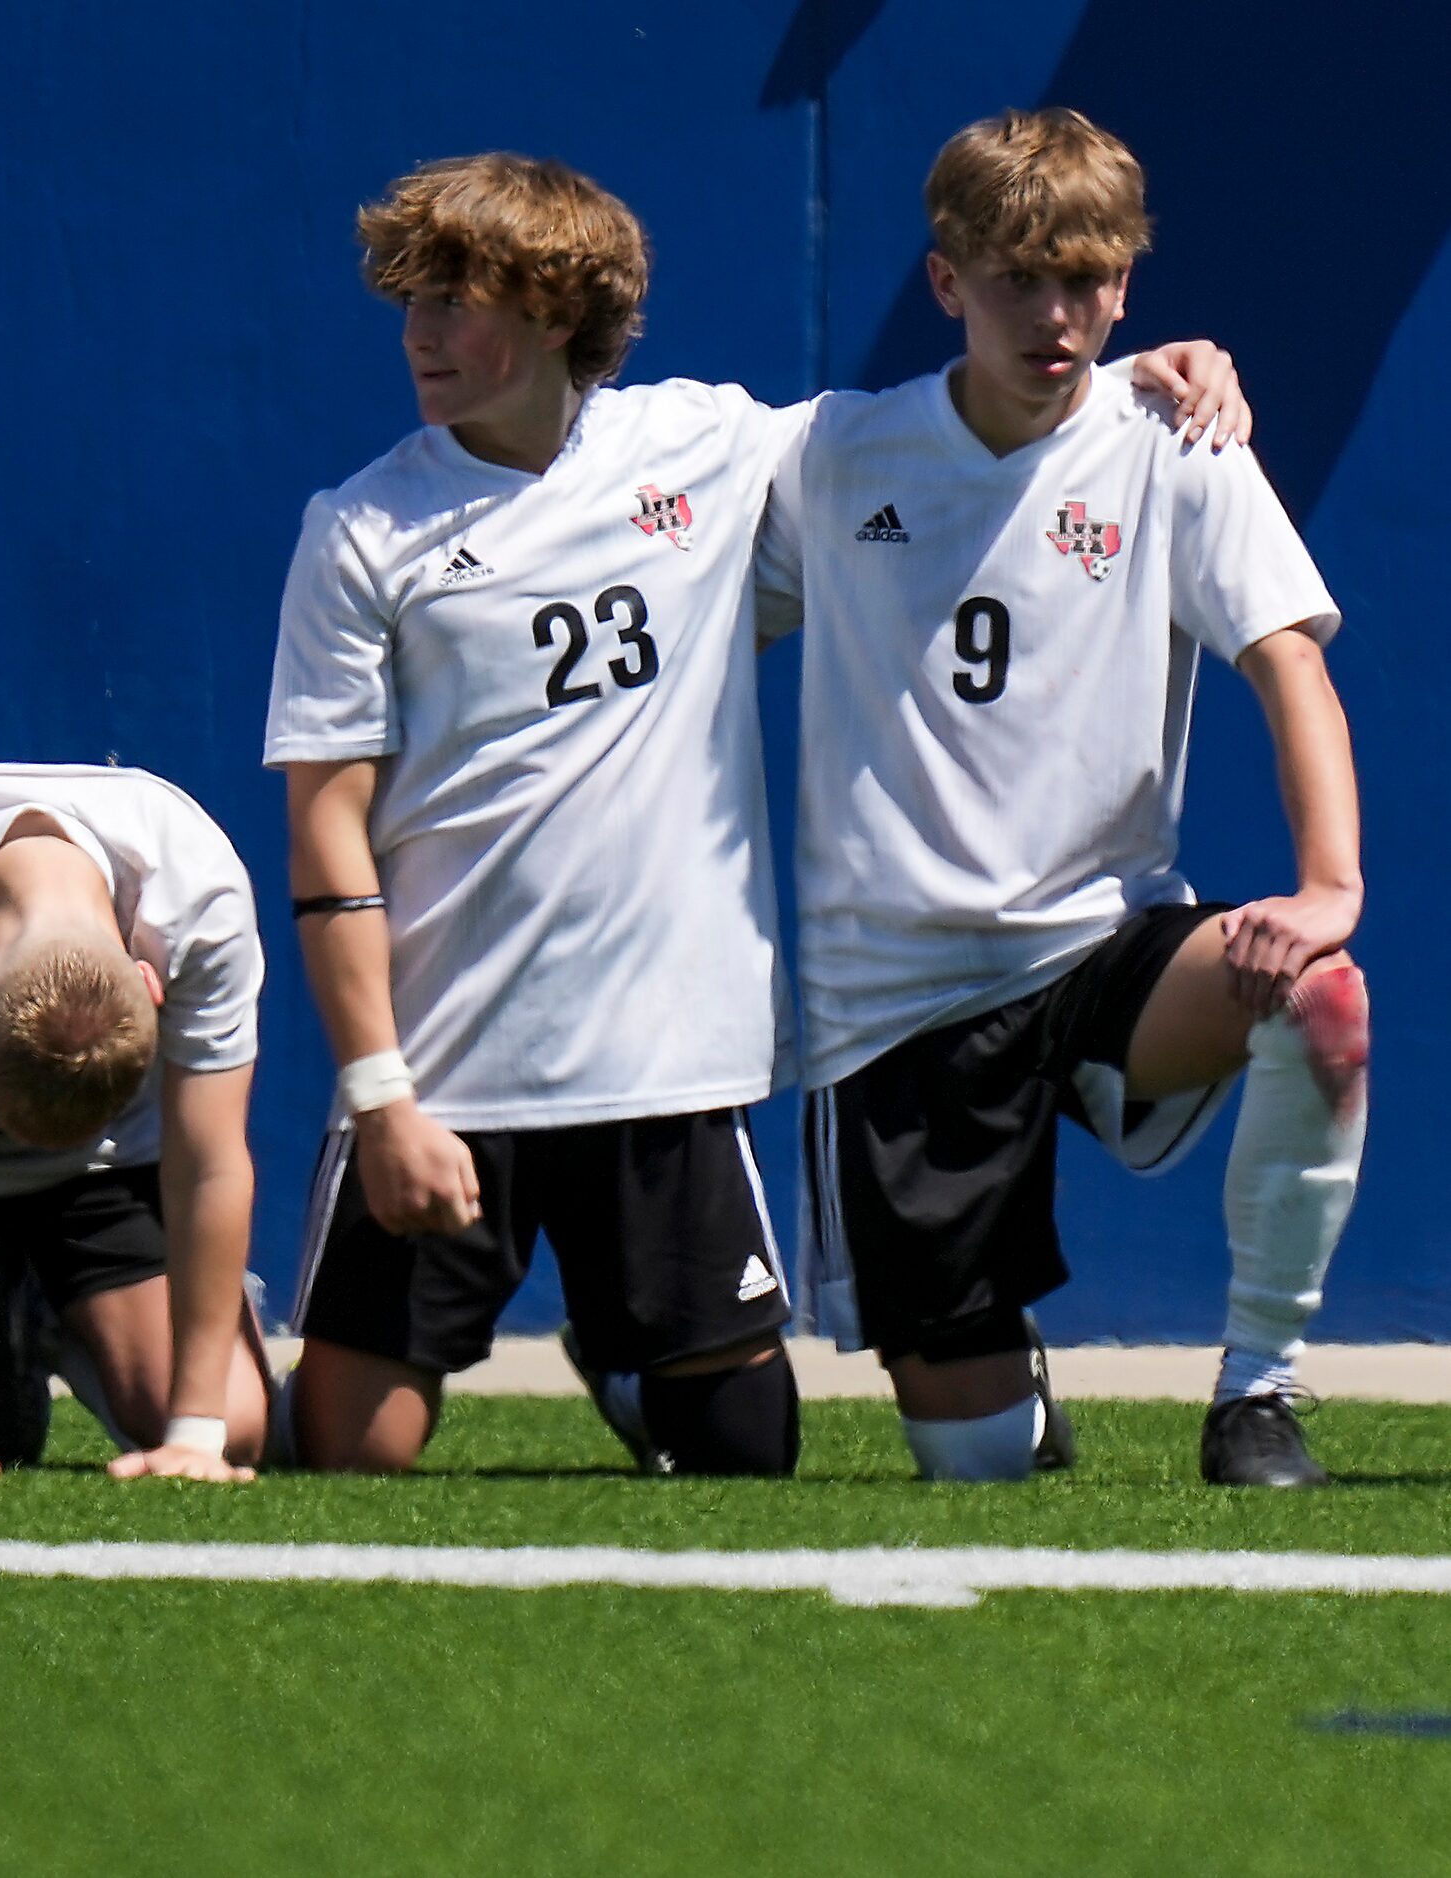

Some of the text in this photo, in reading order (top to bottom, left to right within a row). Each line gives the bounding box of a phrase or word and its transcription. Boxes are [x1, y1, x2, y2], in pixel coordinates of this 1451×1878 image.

[855, 526, 911, 543] adidas
[532, 584, 659, 709] 23
[952, 596, 1010, 704] 9
